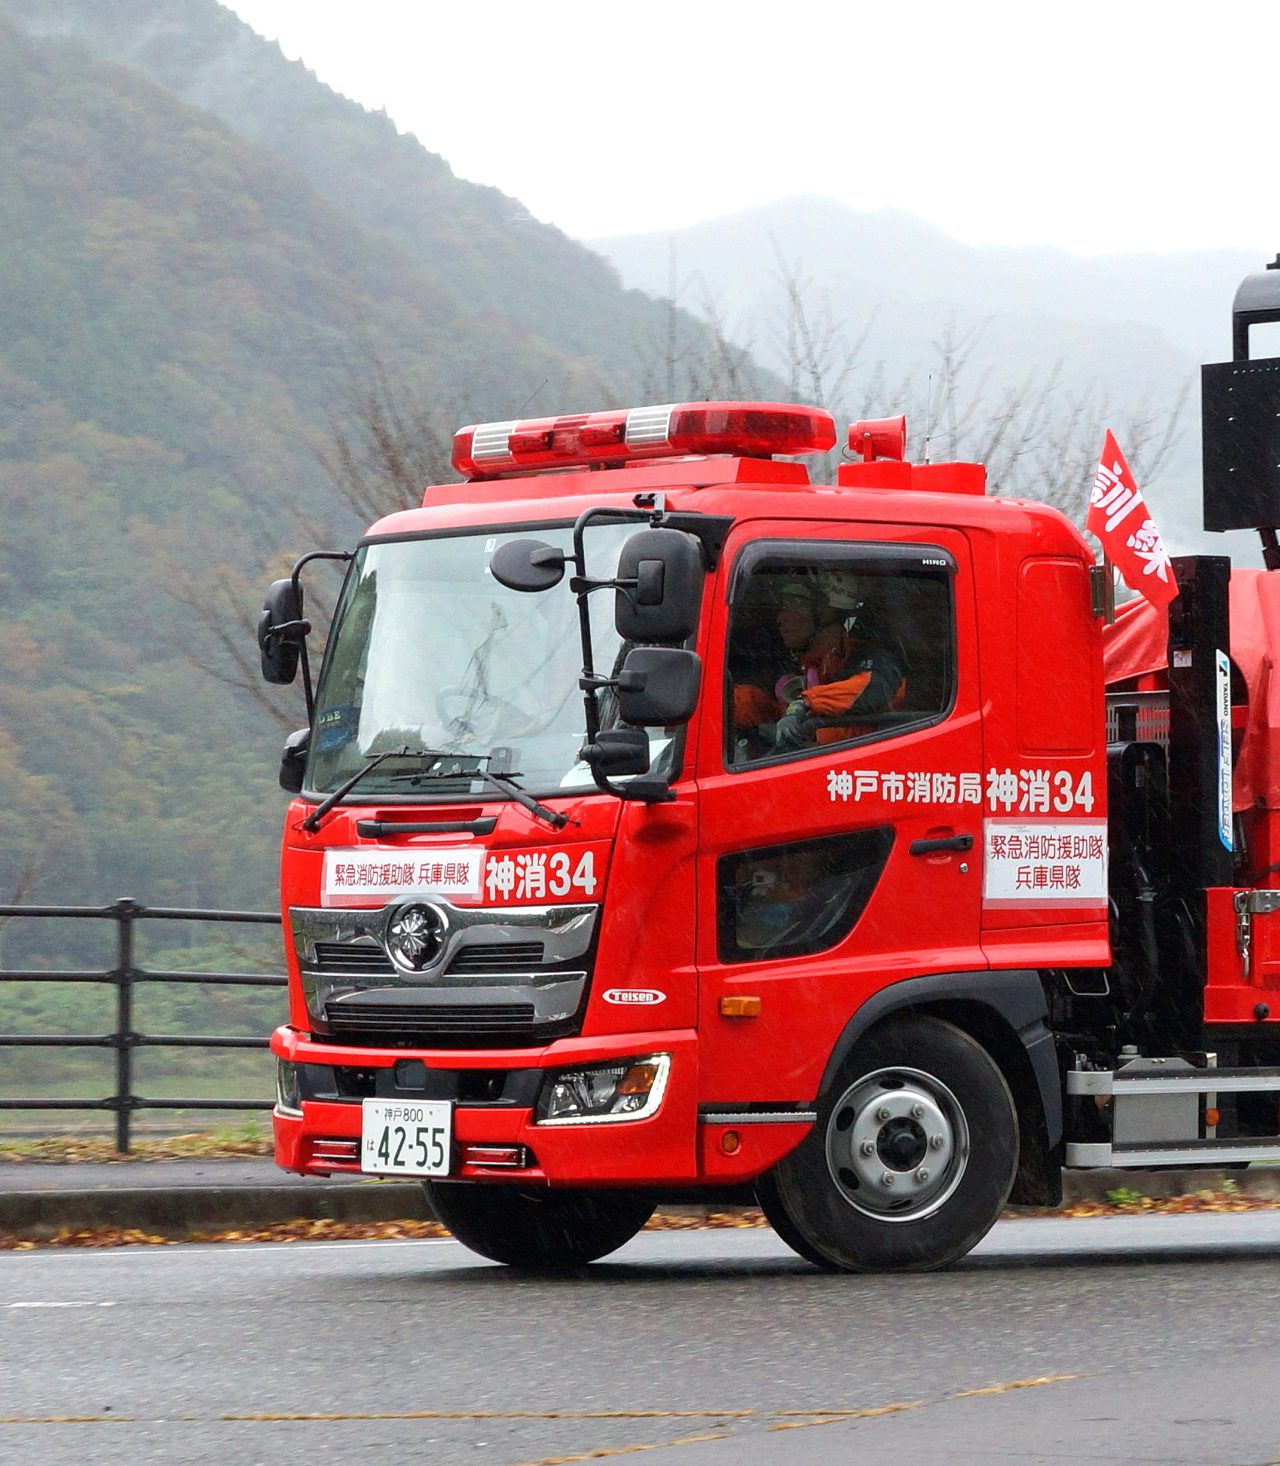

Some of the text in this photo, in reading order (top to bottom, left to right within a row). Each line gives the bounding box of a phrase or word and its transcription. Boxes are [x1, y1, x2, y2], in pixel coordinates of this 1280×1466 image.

[826, 767, 1095, 813] 神戸市消防局 神消34
[1220, 719, 1231, 840] SELF LOADER
[991, 834, 1104, 860] 緊急消防援助隊
[334, 862, 470, 886] 緊急消防援助隊 兵庫県隊
[485, 850, 597, 901] 神消34
[1015, 864, 1082, 890] 兵庫県隊
[366, 1125, 445, 1168] は 42-55
